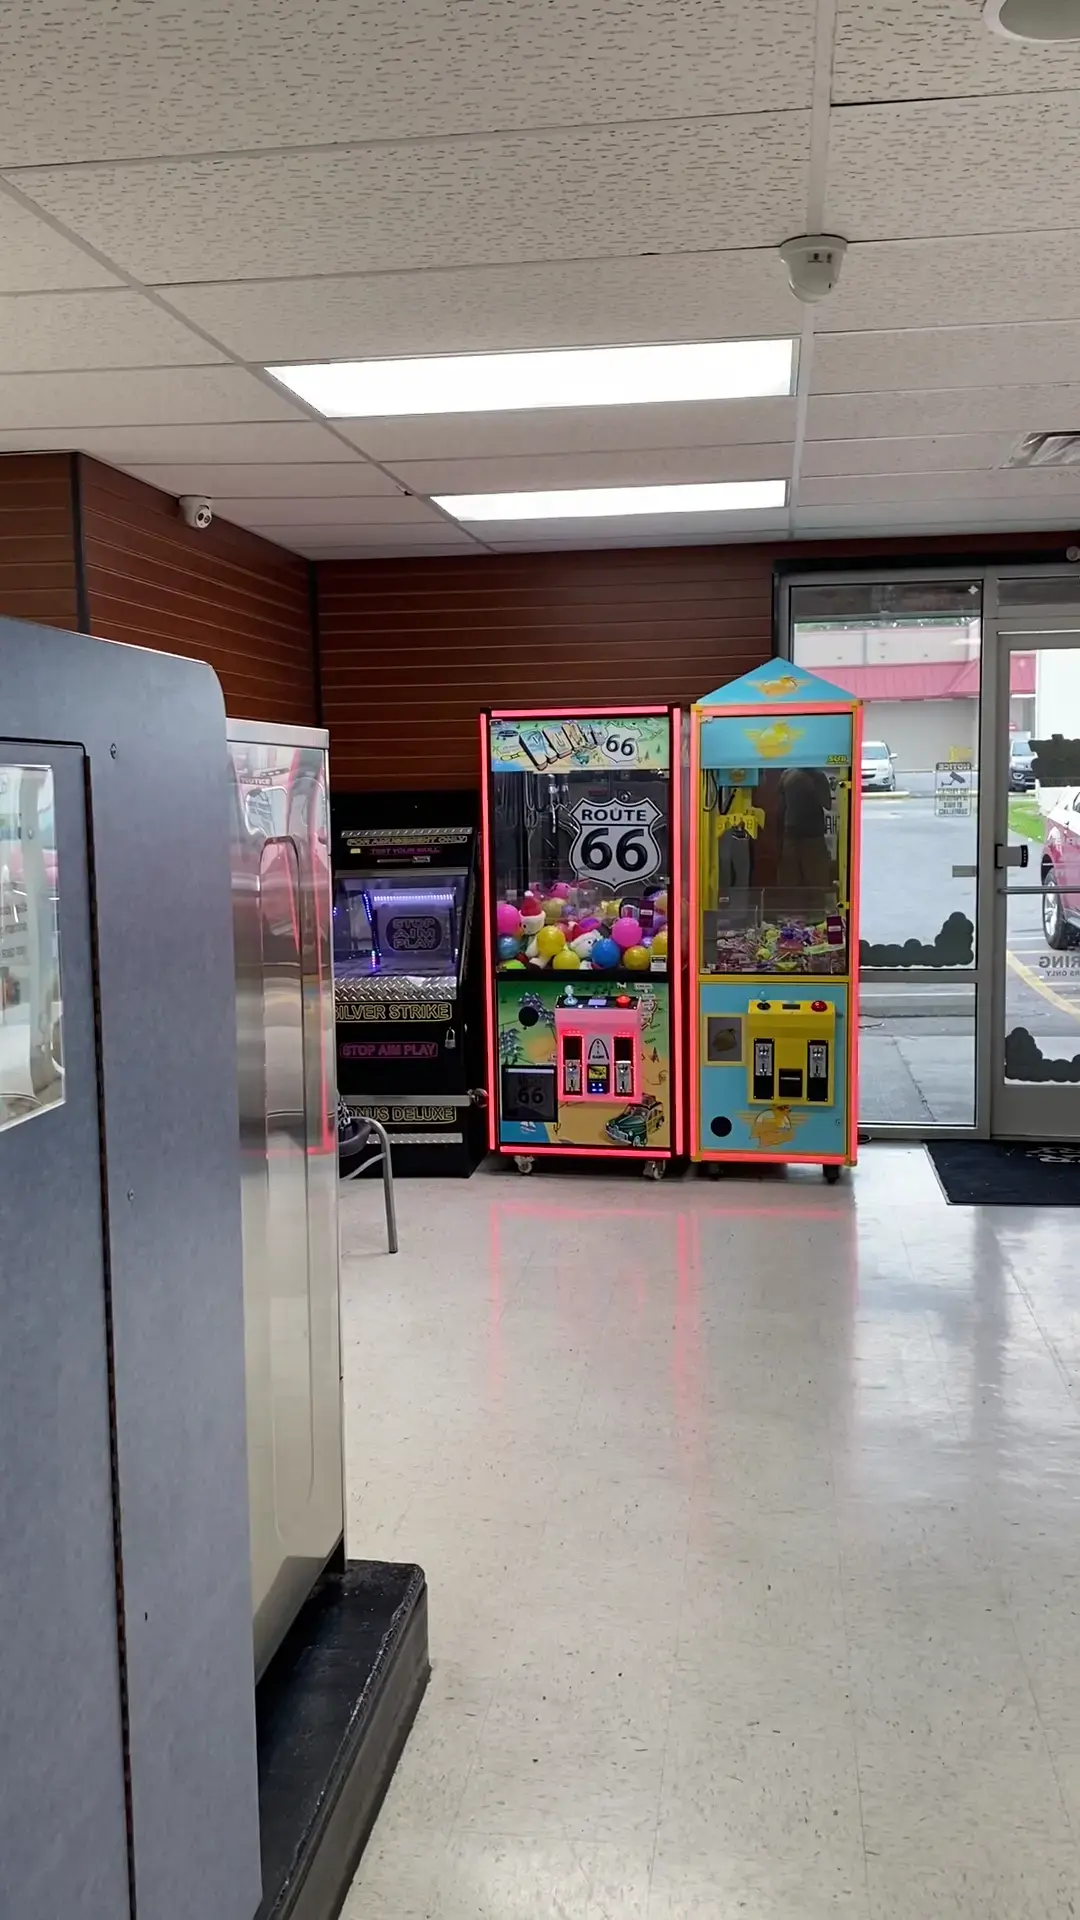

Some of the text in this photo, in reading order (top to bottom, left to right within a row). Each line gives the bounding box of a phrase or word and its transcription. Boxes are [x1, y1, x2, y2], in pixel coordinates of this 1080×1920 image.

[605, 734, 636, 757] 66
[581, 809, 648, 822] ROUTE
[580, 827, 648, 872] 66
[388, 1003, 450, 1019] STRIKE
[342, 1044, 436, 1056] STOP AIM PLAY
[518, 1087, 544, 1104] 66
[391, 1106, 455, 1121] DELUXE
